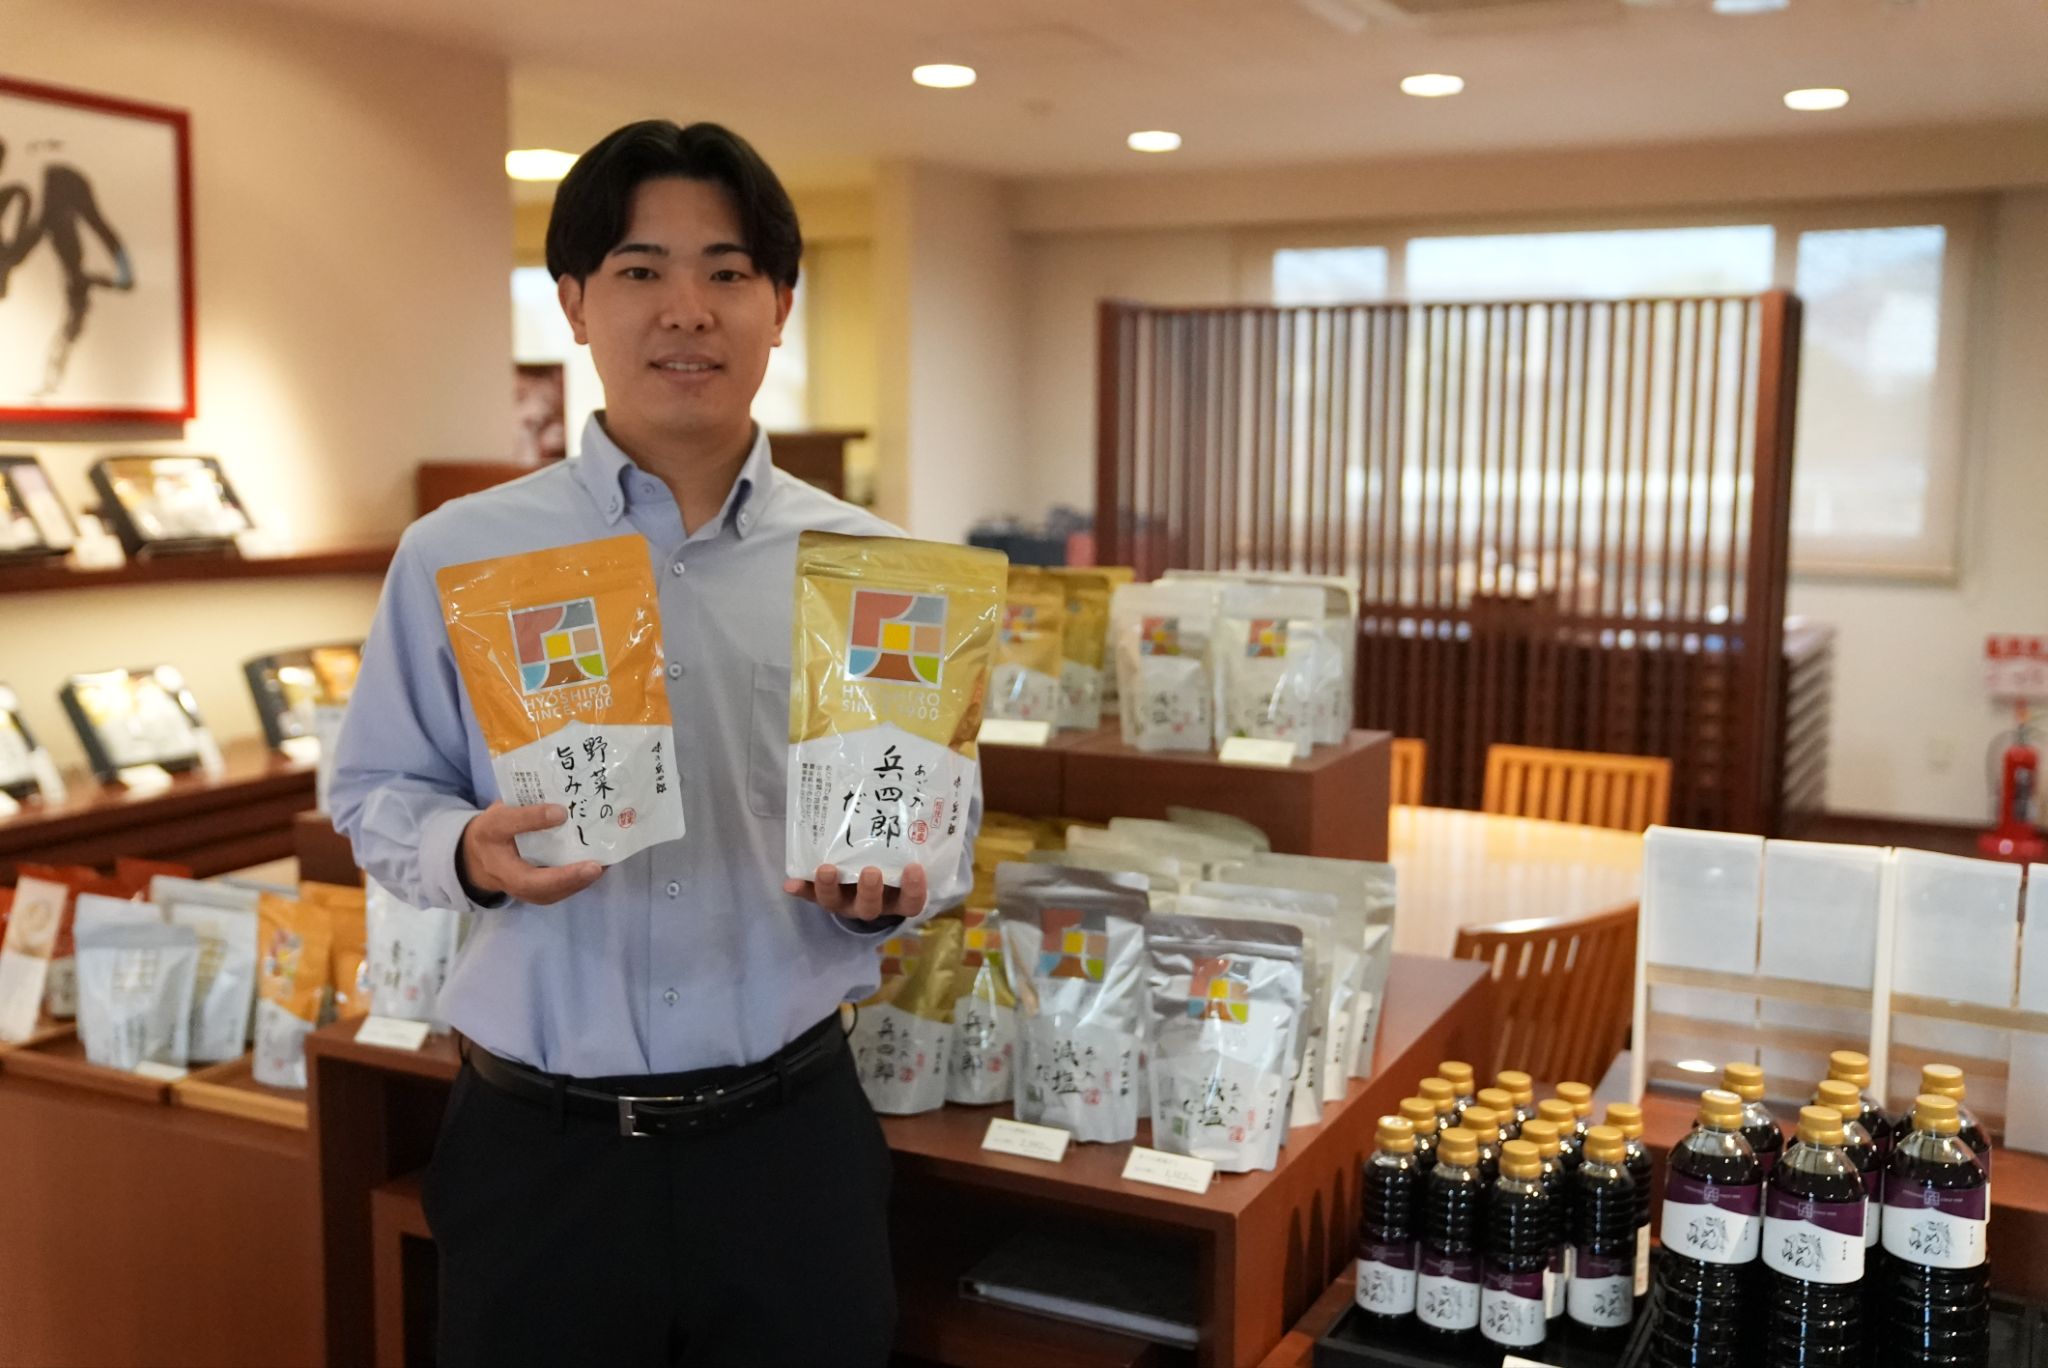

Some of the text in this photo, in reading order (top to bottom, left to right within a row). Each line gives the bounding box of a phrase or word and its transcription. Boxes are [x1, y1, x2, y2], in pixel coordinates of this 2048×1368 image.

[556, 746, 590, 846] 旨みだし
[583, 735, 615, 819] 野菜の
[871, 744, 904, 848] 兵四郎
